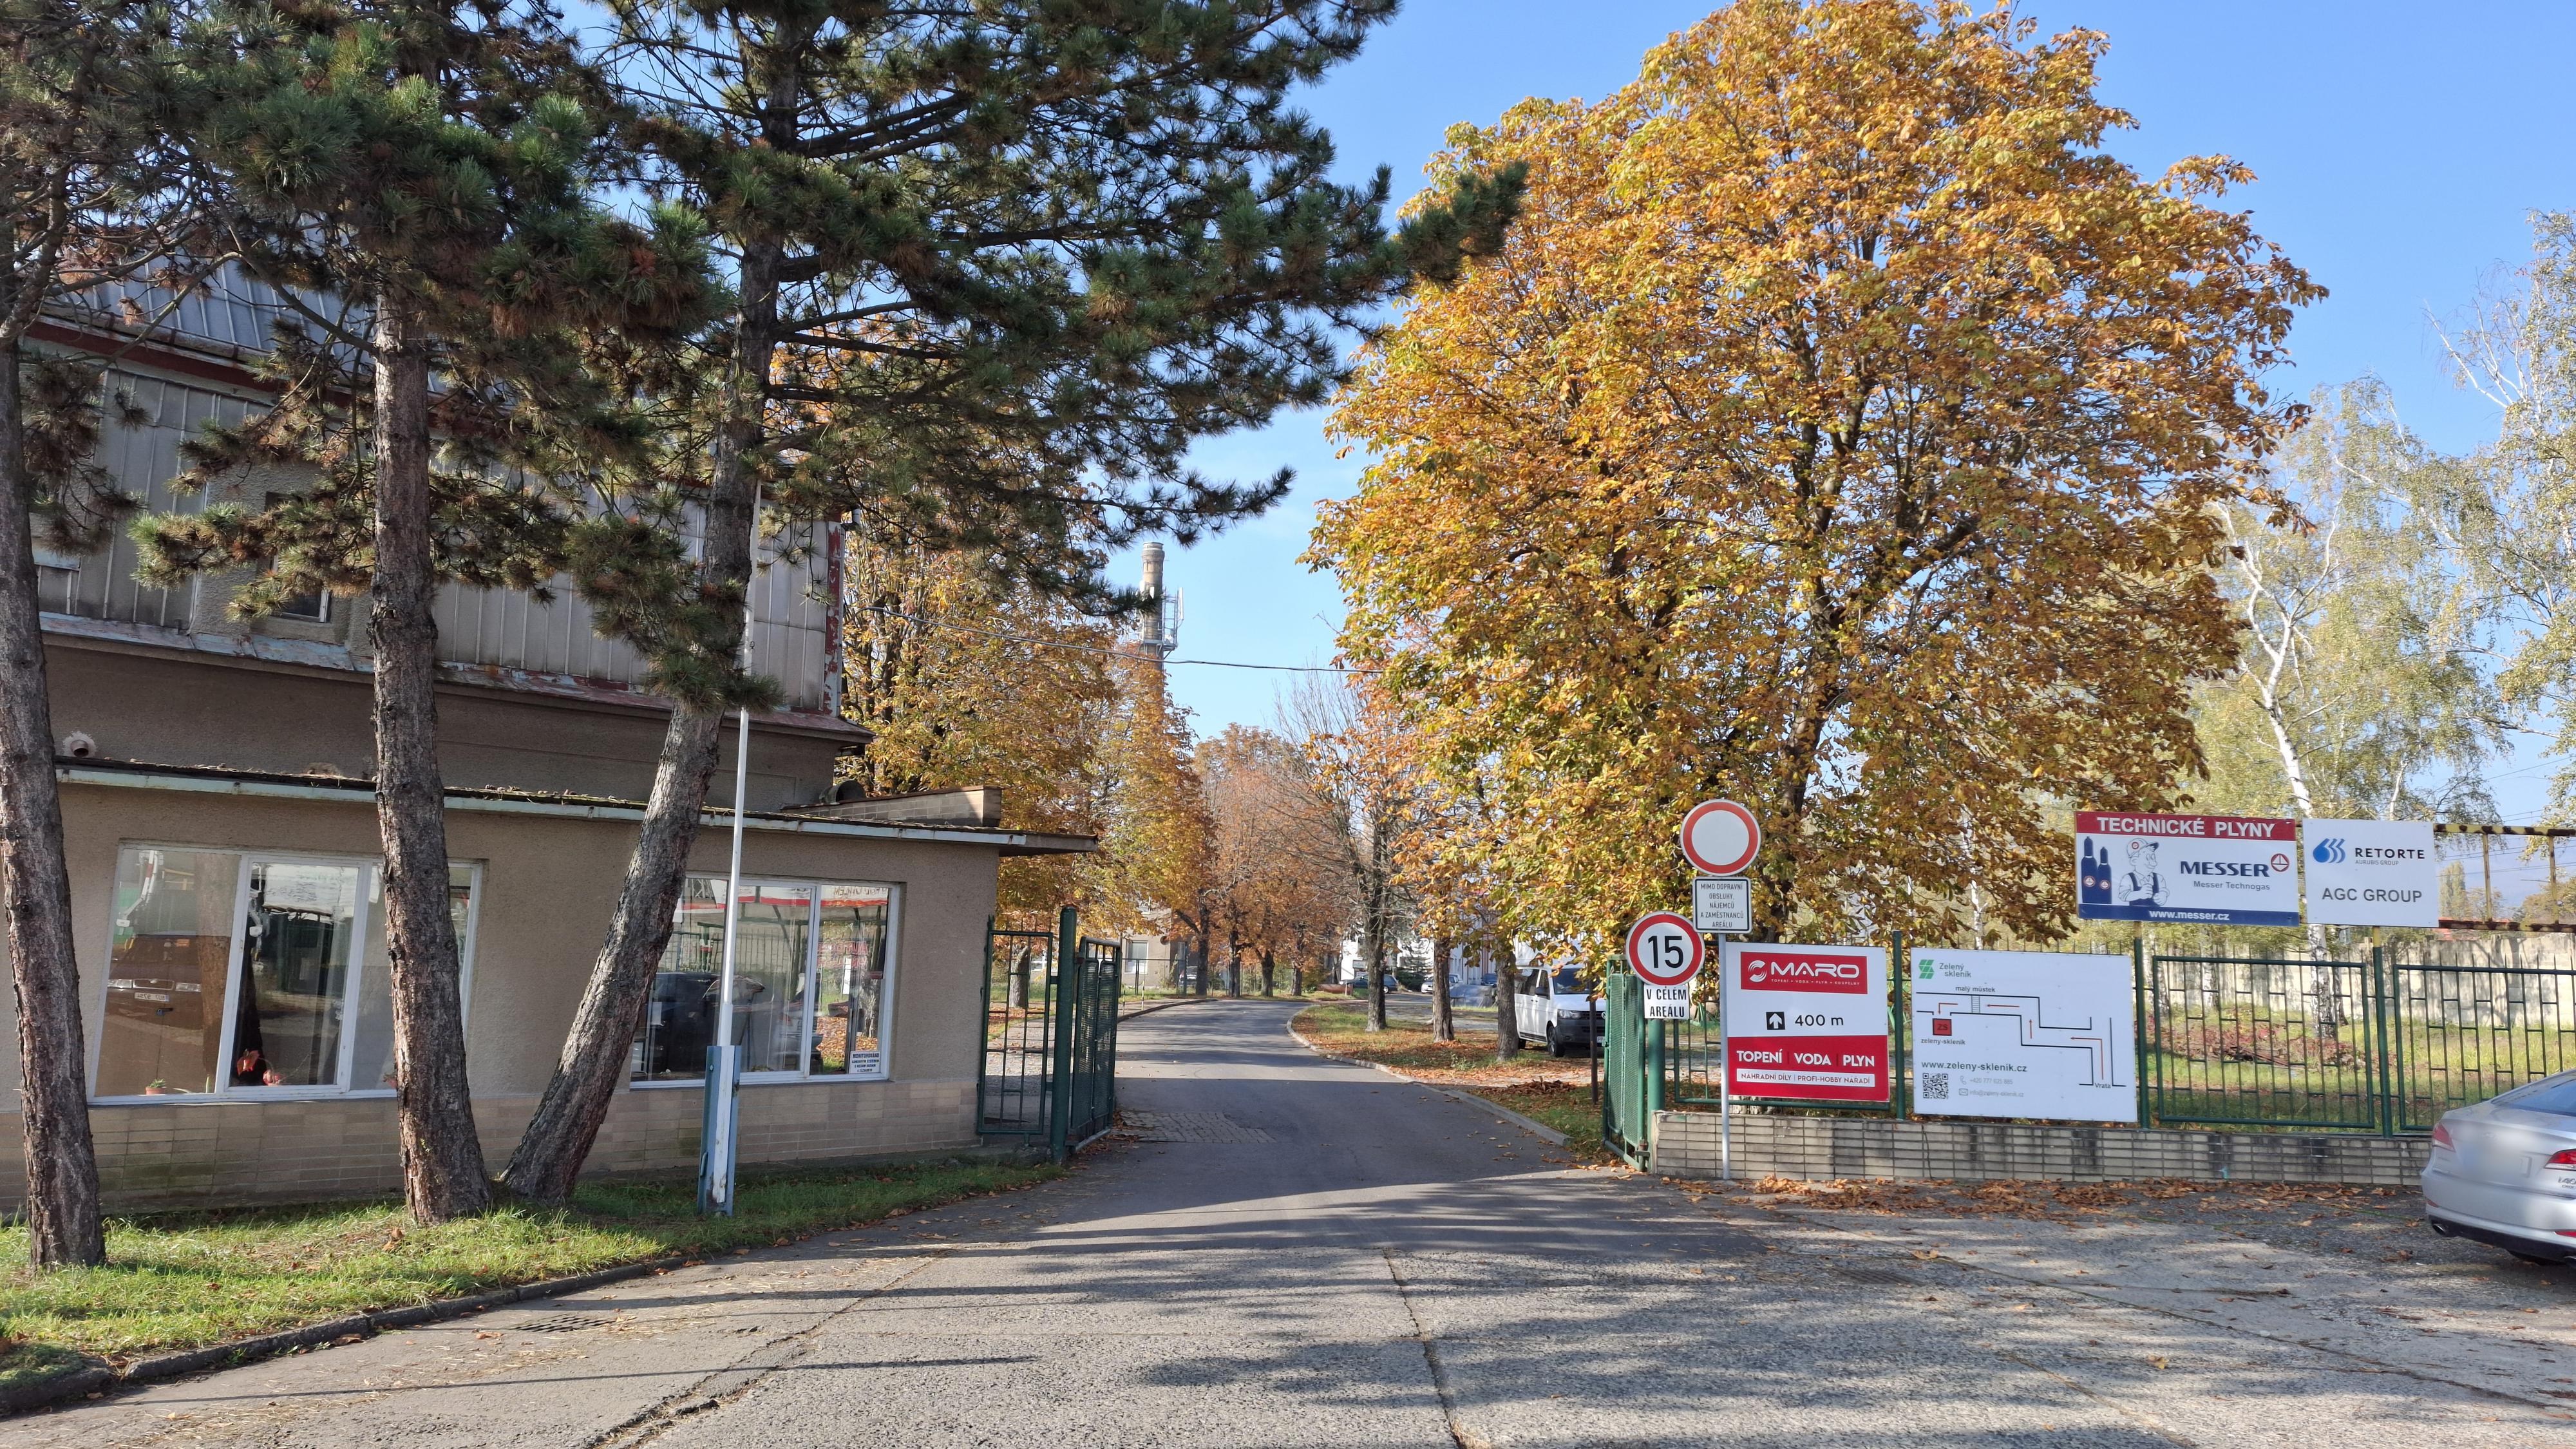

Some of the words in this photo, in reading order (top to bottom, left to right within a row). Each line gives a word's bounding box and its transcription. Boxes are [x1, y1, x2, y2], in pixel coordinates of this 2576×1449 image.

[2097, 817, 2205, 835] TECHNICKÉ
[2215, 821, 2275, 838] PLYNY
[2355, 848, 2425, 859] RETORTE
[2181, 861, 2270, 877] MESSER
[2226, 882, 2270, 891] Technogas
[2322, 887, 2357, 901] AGC
[2363, 889, 2422, 903] GROUP
[2149, 910, 2230, 921] www.messer.cz
[1648, 936, 1683, 969] 15
[1771, 961, 1860, 978] MARO
[1939, 962, 1964, 972] Zelený
[1647, 989, 1651, 999] V
[1656, 987, 1687, 1000] CELÉM
[1650, 1004, 1685, 1018] AREÁLU
[1795, 1014, 1825, 1027] 400
[1831, 1016, 1844, 1026] m
[1736, 1049, 1783, 1063] TOPENÍ
[1794, 1053, 1832, 1065] VODA
[1843, 1055, 1875, 1066] PLYN
[1922, 1062, 2027, 1072] www.zeleny-sklenik.cz
[1844, 1075, 1870, 1084] NÁŘADÍ
